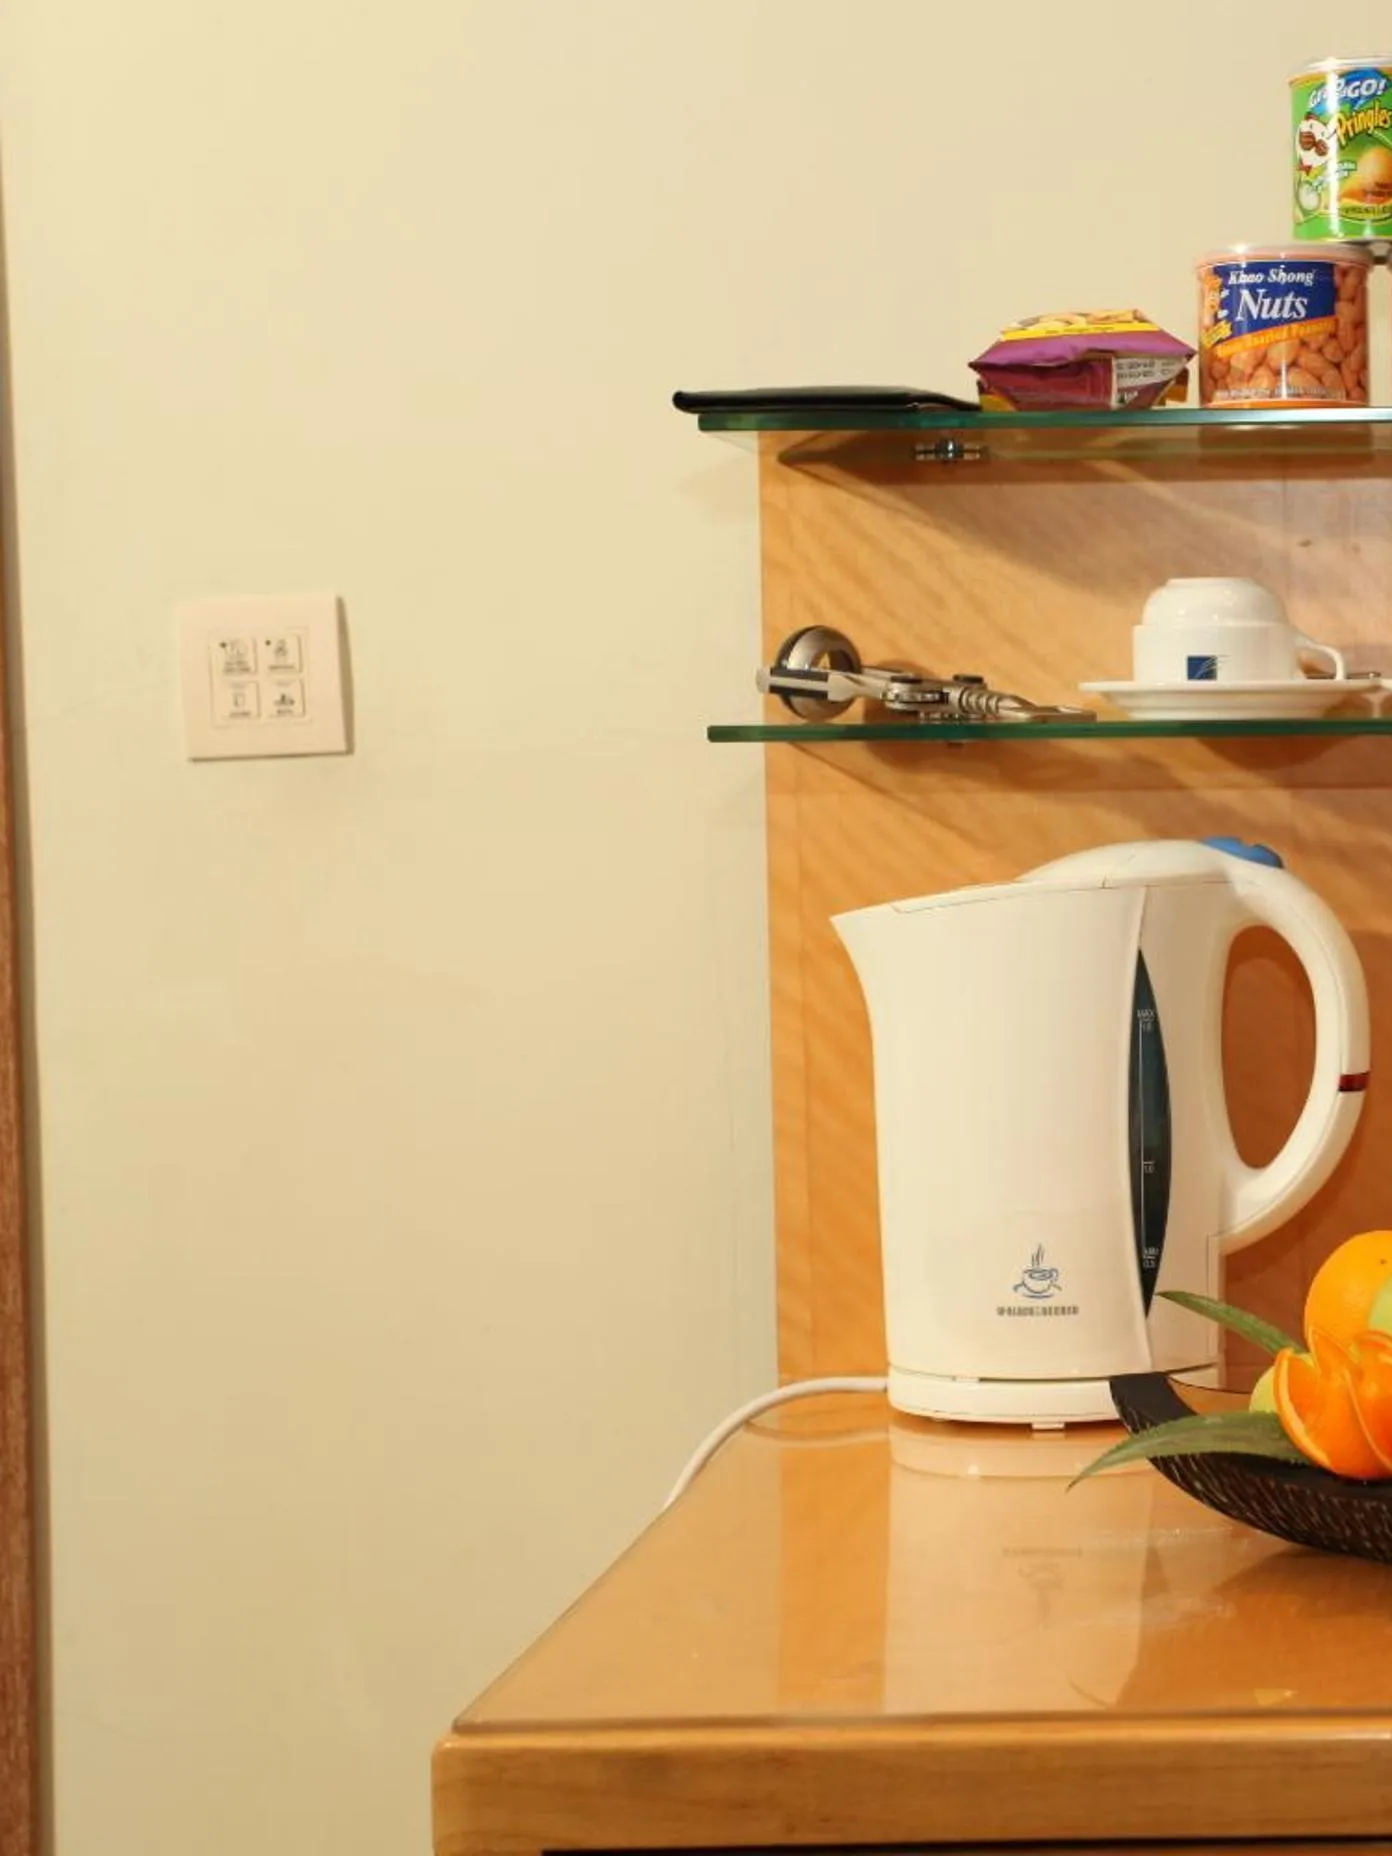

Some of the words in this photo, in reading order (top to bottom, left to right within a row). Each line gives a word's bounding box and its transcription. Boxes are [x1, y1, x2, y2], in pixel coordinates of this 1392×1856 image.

[1228, 271, 1263, 285] Khao
[1267, 268, 1315, 286] Shong
[1235, 289, 1308, 321] Nuts
